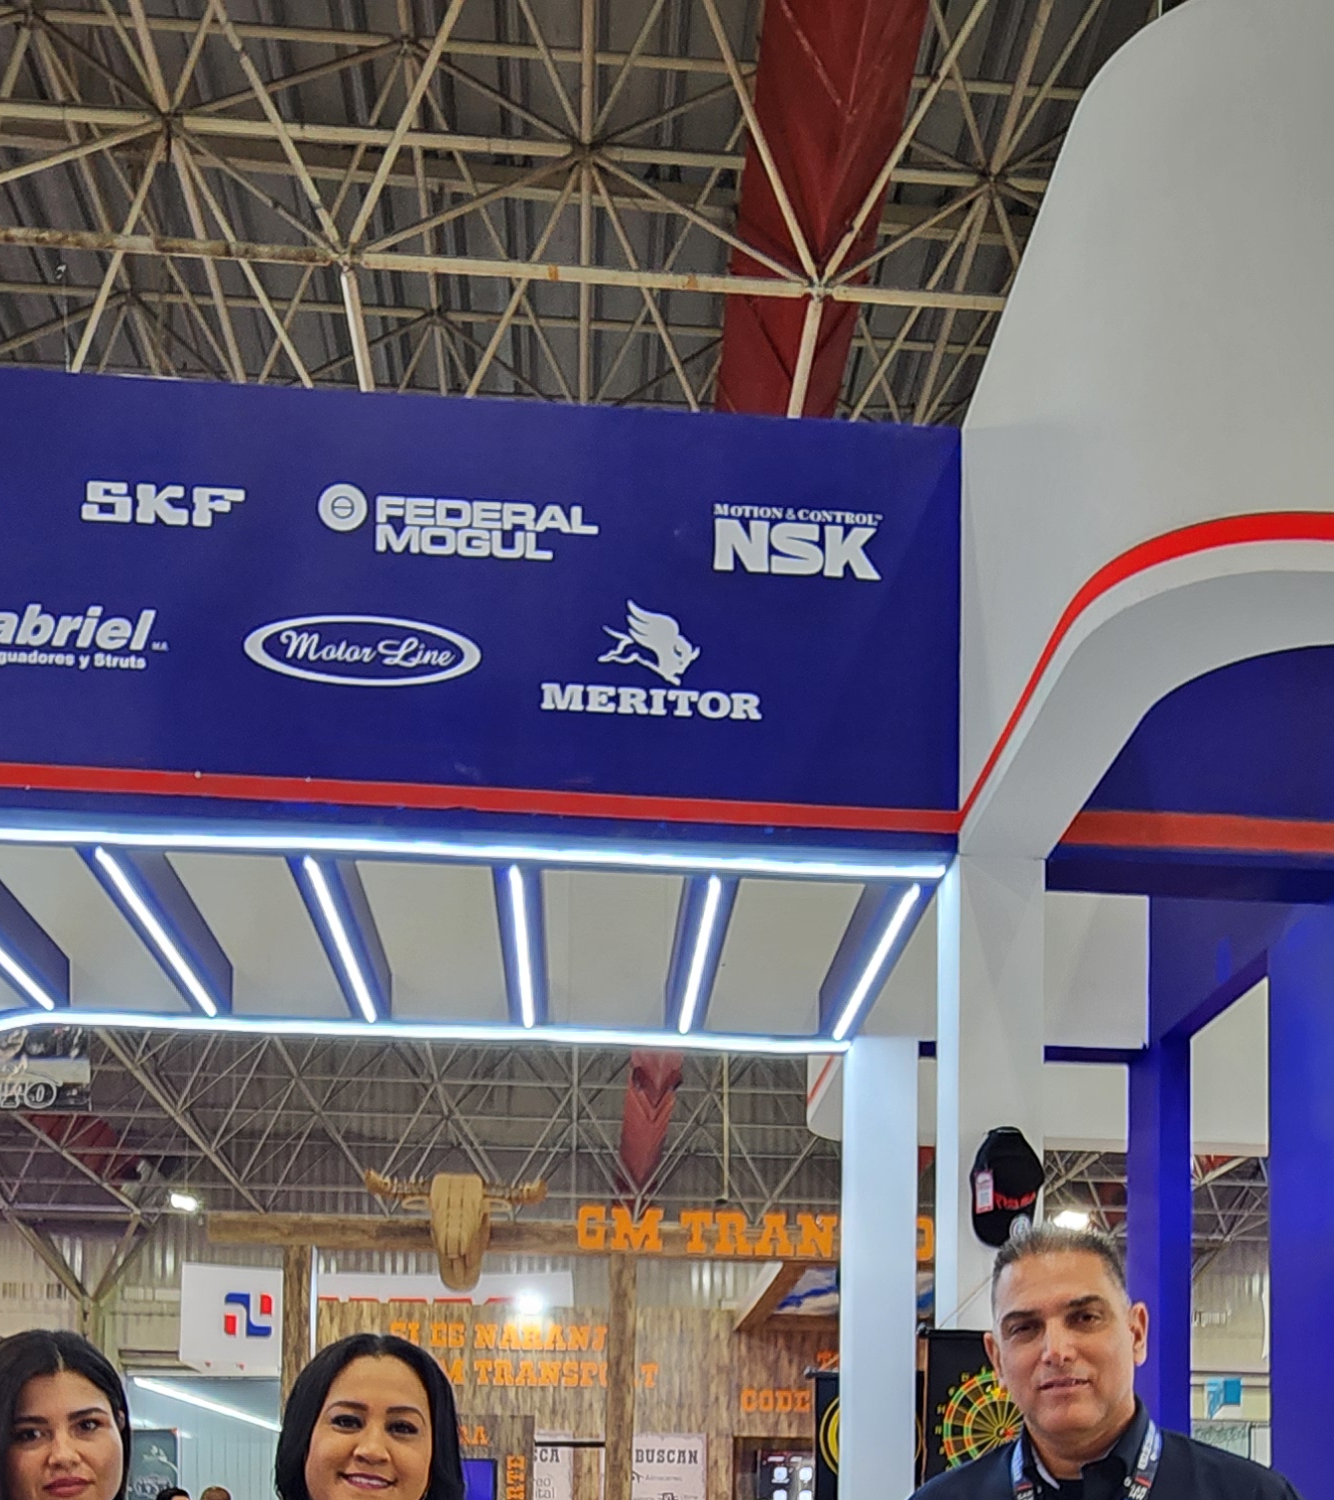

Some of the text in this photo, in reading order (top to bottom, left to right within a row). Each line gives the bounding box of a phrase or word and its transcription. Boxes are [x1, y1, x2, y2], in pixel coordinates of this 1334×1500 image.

[80, 480, 245, 527] SKF
[376, 496, 599, 535] FEDERAL
[714, 504, 783, 519] MOTION
[375, 523, 553, 561] MOGUL
[713, 518, 882, 580] NSK
[79, 655, 90, 670] y
[94, 653, 146, 669] Struts
[280, 631, 455, 668] Motor Line
[540, 682, 763, 721] MERITOR
[577, 1204, 664, 1251] GM
[635, 1449, 699, 1464] BUSCAN
